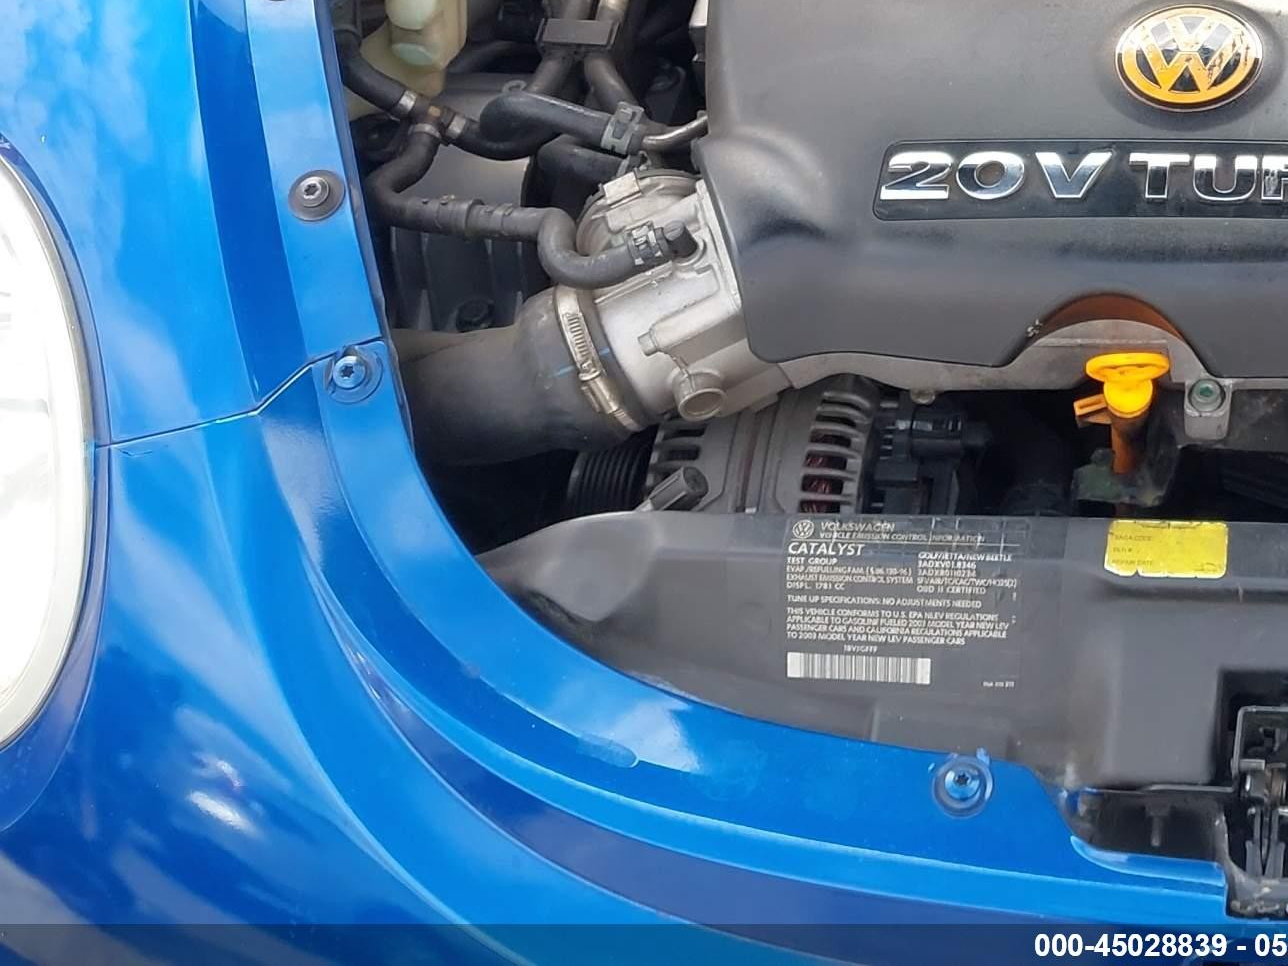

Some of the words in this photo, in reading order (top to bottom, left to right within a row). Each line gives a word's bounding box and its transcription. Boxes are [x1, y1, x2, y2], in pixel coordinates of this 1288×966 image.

[821, 522, 896, 532] VOLKSWAGEN
[788, 542, 865, 556] CATALYST
[808, 557, 838, 565] GROUP
[820, 574, 852, 582] EMISSION
[852, 575, 885, 583] CONTROL
[886, 576, 913, 584] SYSTEM
[916, 585, 934, 593] OBD
[946, 586, 986, 594] CERTIFIED
[788, 594, 808, 602] TUNE
[882, 597, 895, 605] NO
[896, 598, 950, 607] ADJUSTMENTS
[952, 600, 982, 608] NEEDED
[804, 608, 835, 616] VEHICLE
[836, 608, 879, 617] CONFORMS
[908, 611, 923, 619] EPA
[924, 612, 944, 620] NLEV
[945, 612, 999, 621] REGULATIONS
[786, 616, 828, 624] APPLICABLE
[842, 617, 878, 625] GASOLINE
[880, 618, 908, 626] FUELED
[928, 620, 954, 628] MODEL
[956, 621, 976, 629] YEAR
[976, 622, 994, 630] NEW
[994, 622, 1010, 630] LEV
[786, 624, 828, 632] PASSENGER
[828, 624, 847, 633] CARS
[848, 626, 865, 634] AND
[866, 626, 910, 634] CALIFORNIA
[910, 628, 962, 636] REGULATIONS
[963, 629, 1007, 638] APPLICABLE
[788, 632, 798, 640] TO
[818, 632, 846, 641] MODEL
[847, 634, 867, 642] YEAR
[868, 634, 886, 643] NEW
[887, 635, 902, 643] LEV
[902, 636, 945, 644] PASSENGER
[946, 637, 966, 646] CARS
